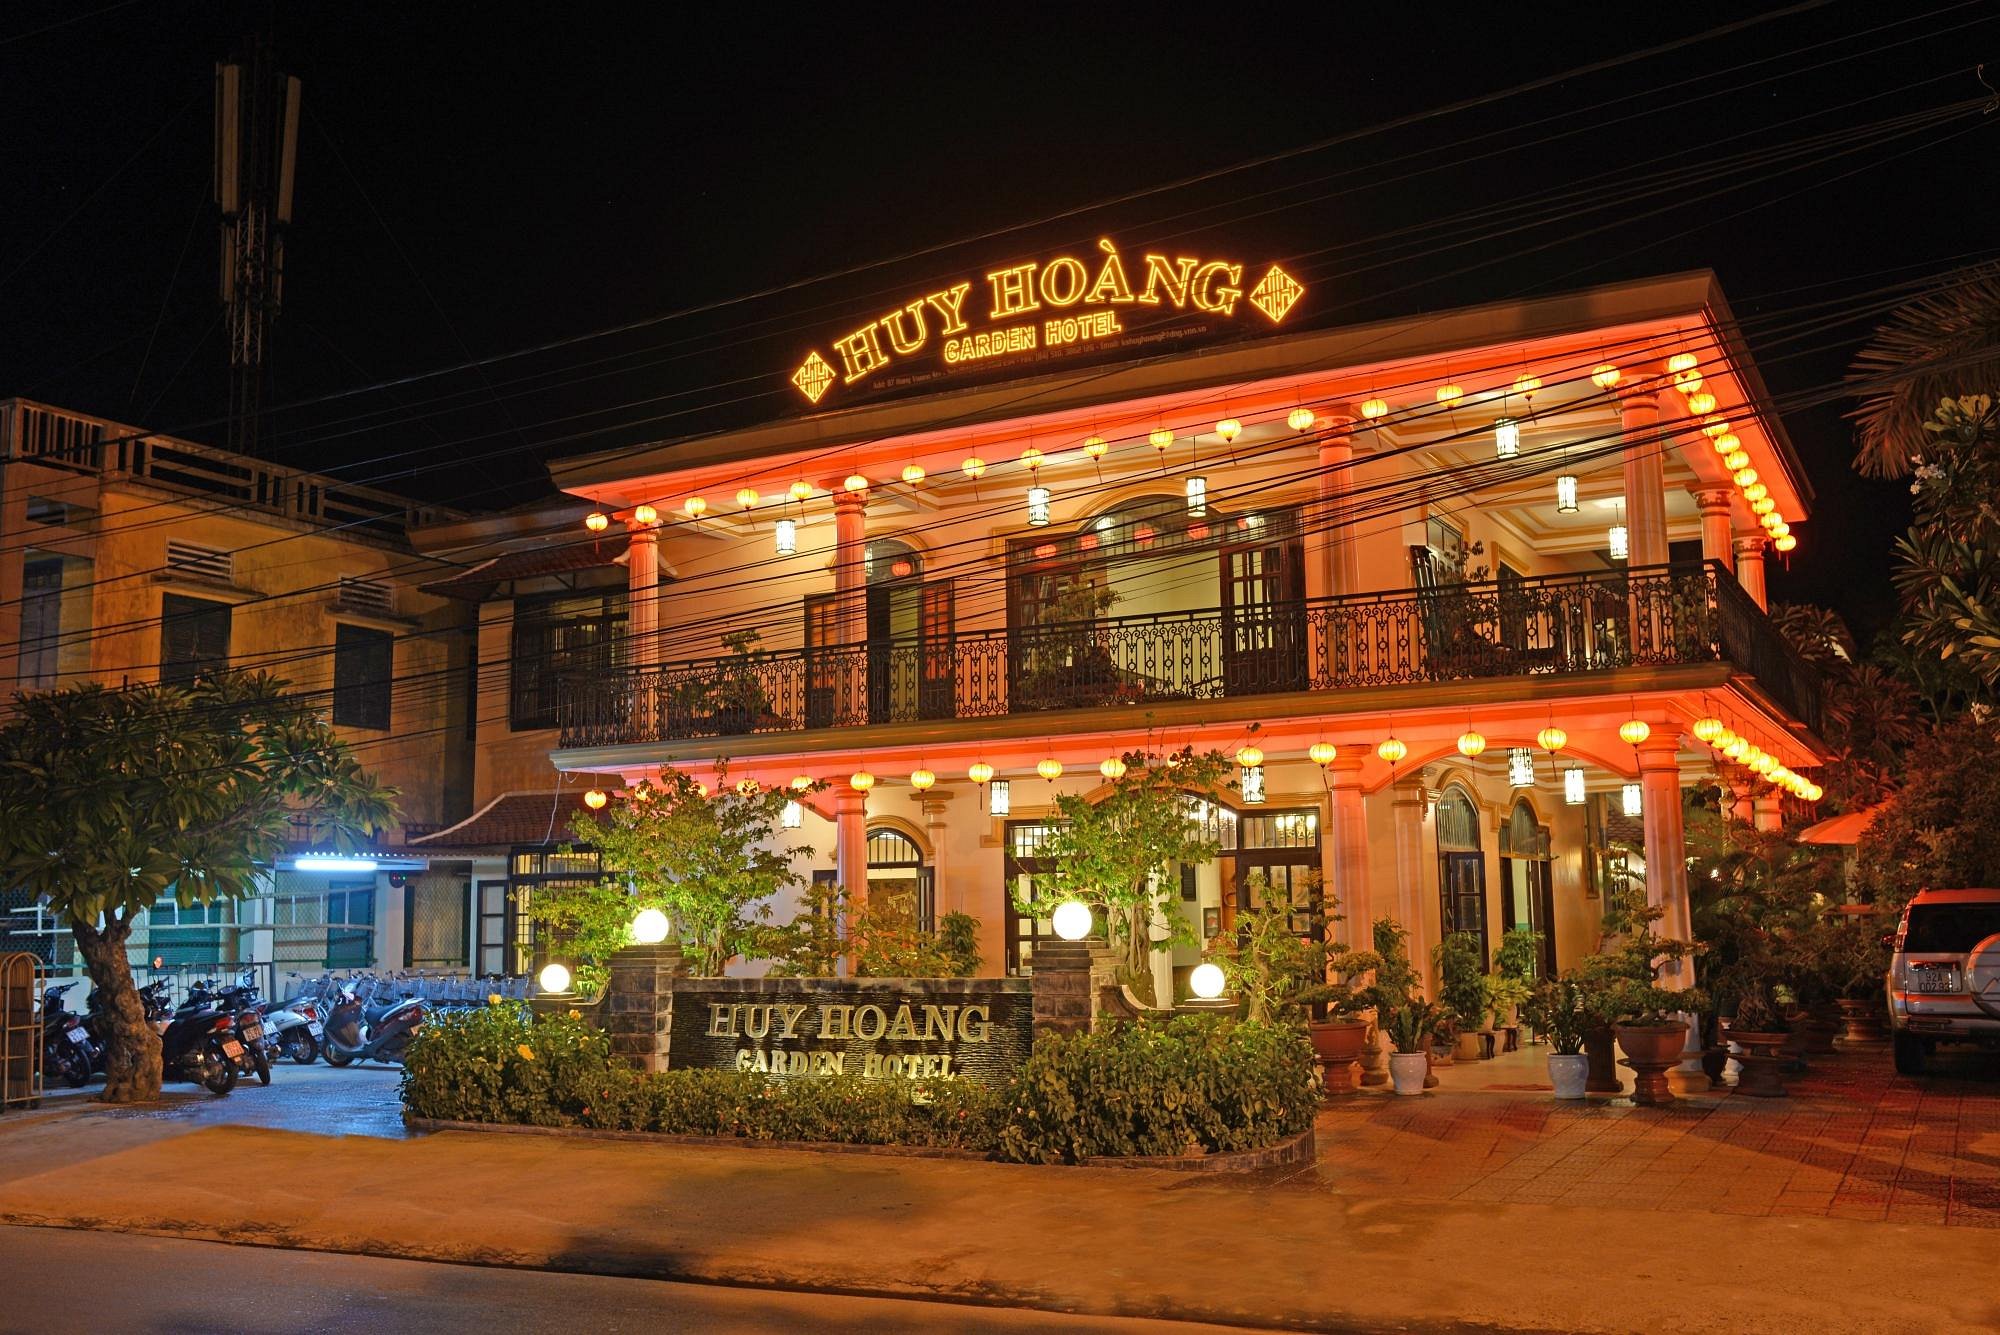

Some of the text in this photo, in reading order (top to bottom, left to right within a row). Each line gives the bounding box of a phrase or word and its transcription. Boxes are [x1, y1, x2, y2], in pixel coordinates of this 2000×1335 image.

[833, 282, 971, 384] HUY
[987, 239, 1243, 318] HOÀNG
[943, 310, 1122, 364] GARDEN HOTEL
[705, 999, 995, 1044] HUY HOÀNG
[735, 1048, 957, 1081] GARDEN HOTEL
